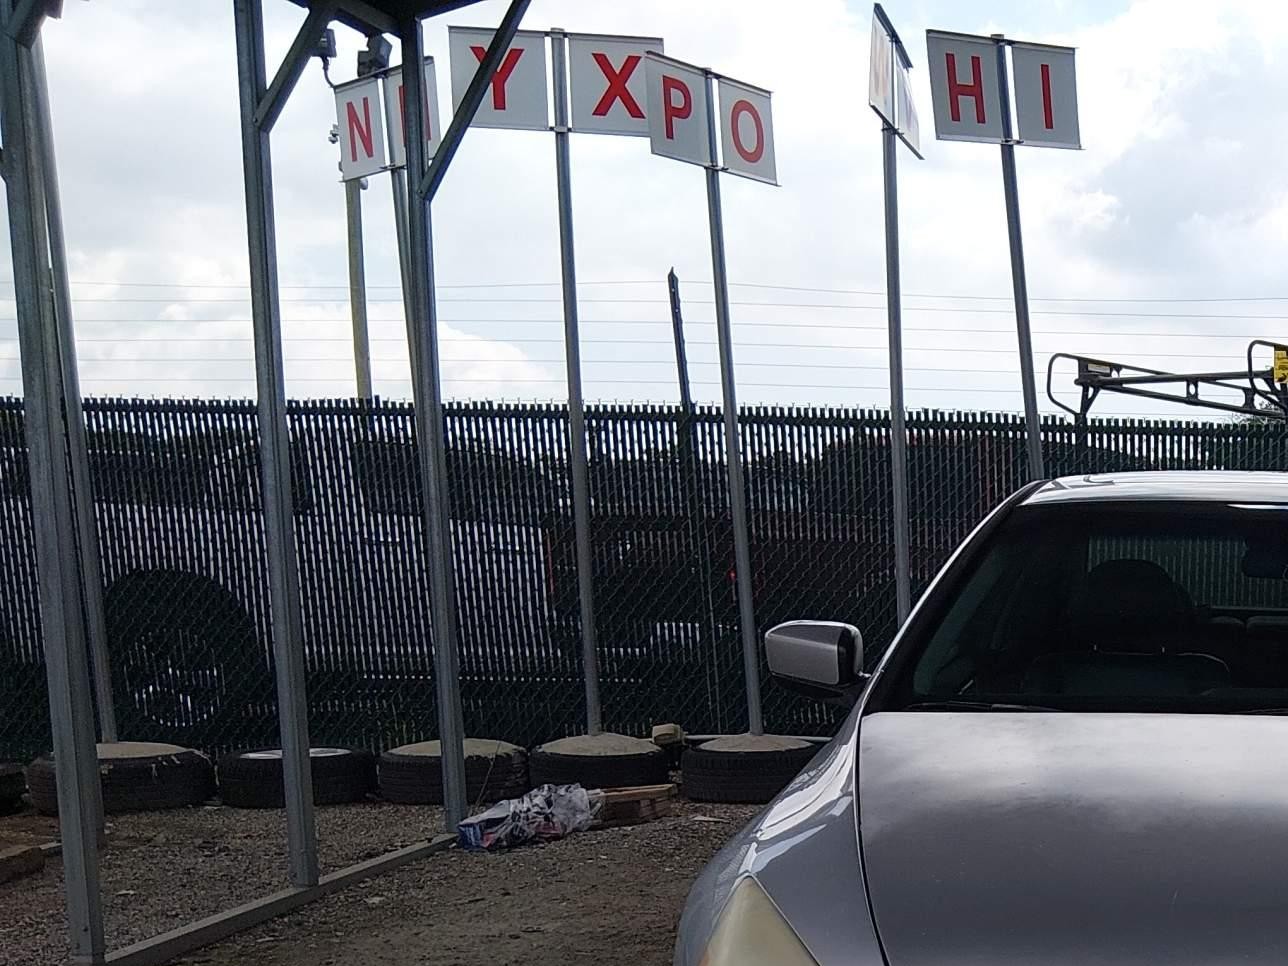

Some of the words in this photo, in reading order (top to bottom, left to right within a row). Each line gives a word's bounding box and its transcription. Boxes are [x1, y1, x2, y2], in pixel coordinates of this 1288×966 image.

[469, 45, 526, 111] Y
[591, 52, 646, 119] X
[661, 74, 693, 141] P
[945, 52, 987, 125] H
[1040, 63, 1055, 130] I
[345, 96, 375, 162] N
[730, 99, 765, 164] O
